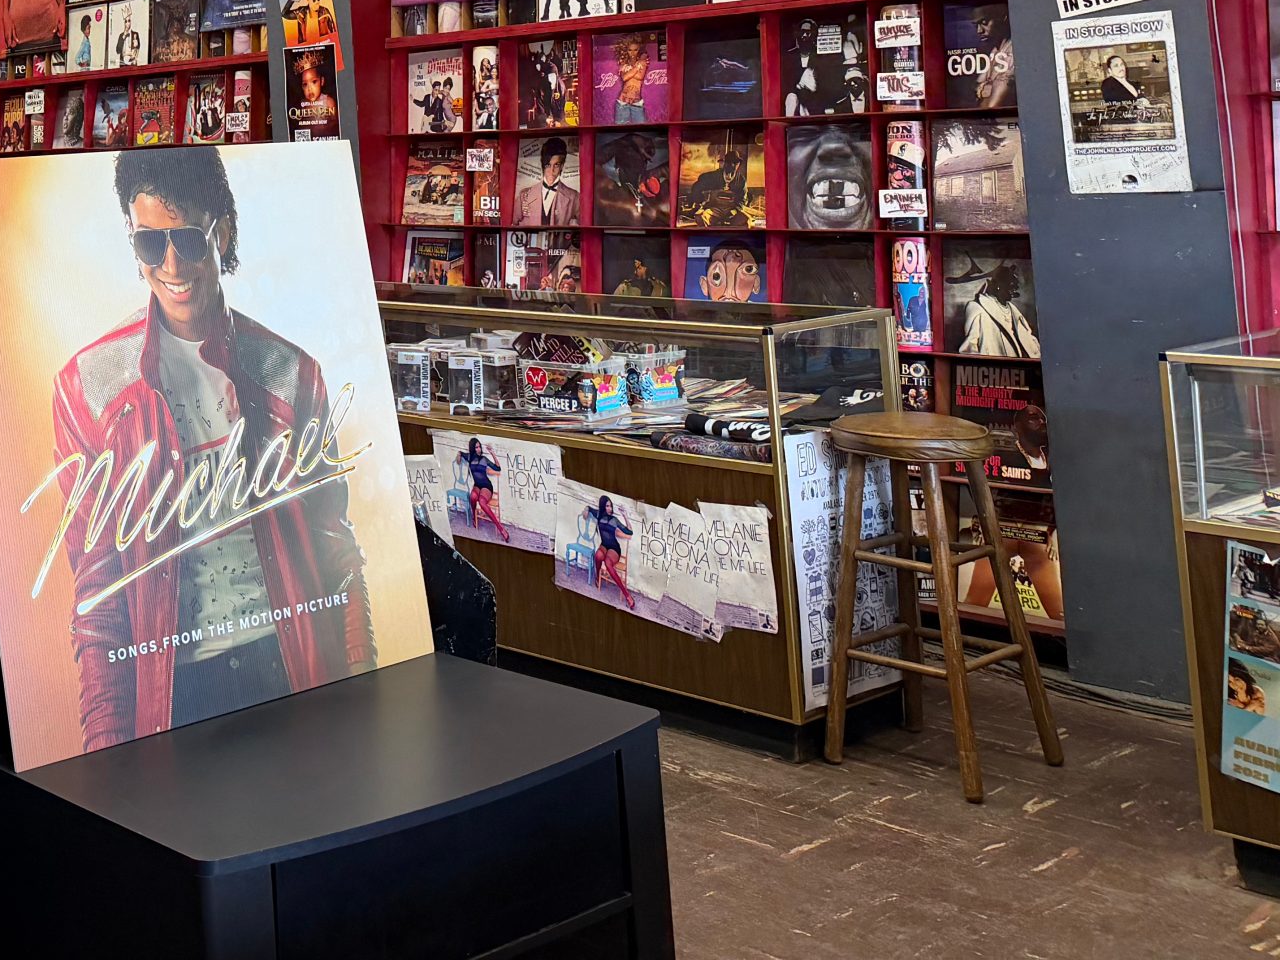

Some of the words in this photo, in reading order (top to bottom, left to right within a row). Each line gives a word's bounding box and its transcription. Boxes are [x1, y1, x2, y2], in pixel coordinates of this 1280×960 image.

[1065, 28, 1078, 39] IN
[1081, 23, 1130, 38] STORES
[1132, 20, 1163, 33] NOW
[947, 53, 1008, 76] GOD'S
[288, 106, 316, 120] QUEEN
[317, 105, 336, 118] PEN
[956, 365, 1029, 390] MICHAEL
[540, 396, 569, 409] PERCEE
[570, 399, 578, 410] P
[506, 454, 557, 476] MELANIE
[1001, 466, 1031, 479] SAINTS
[21, 383, 373, 599] Michael
[507, 471, 547, 491] FIONA
[108, 639, 158, 663] SONGS
[163, 628, 203, 649] FROM
[207, 621, 235, 636] THE
[239, 607, 293, 630] MOTION
[296, 592, 350, 615] PICTURE
